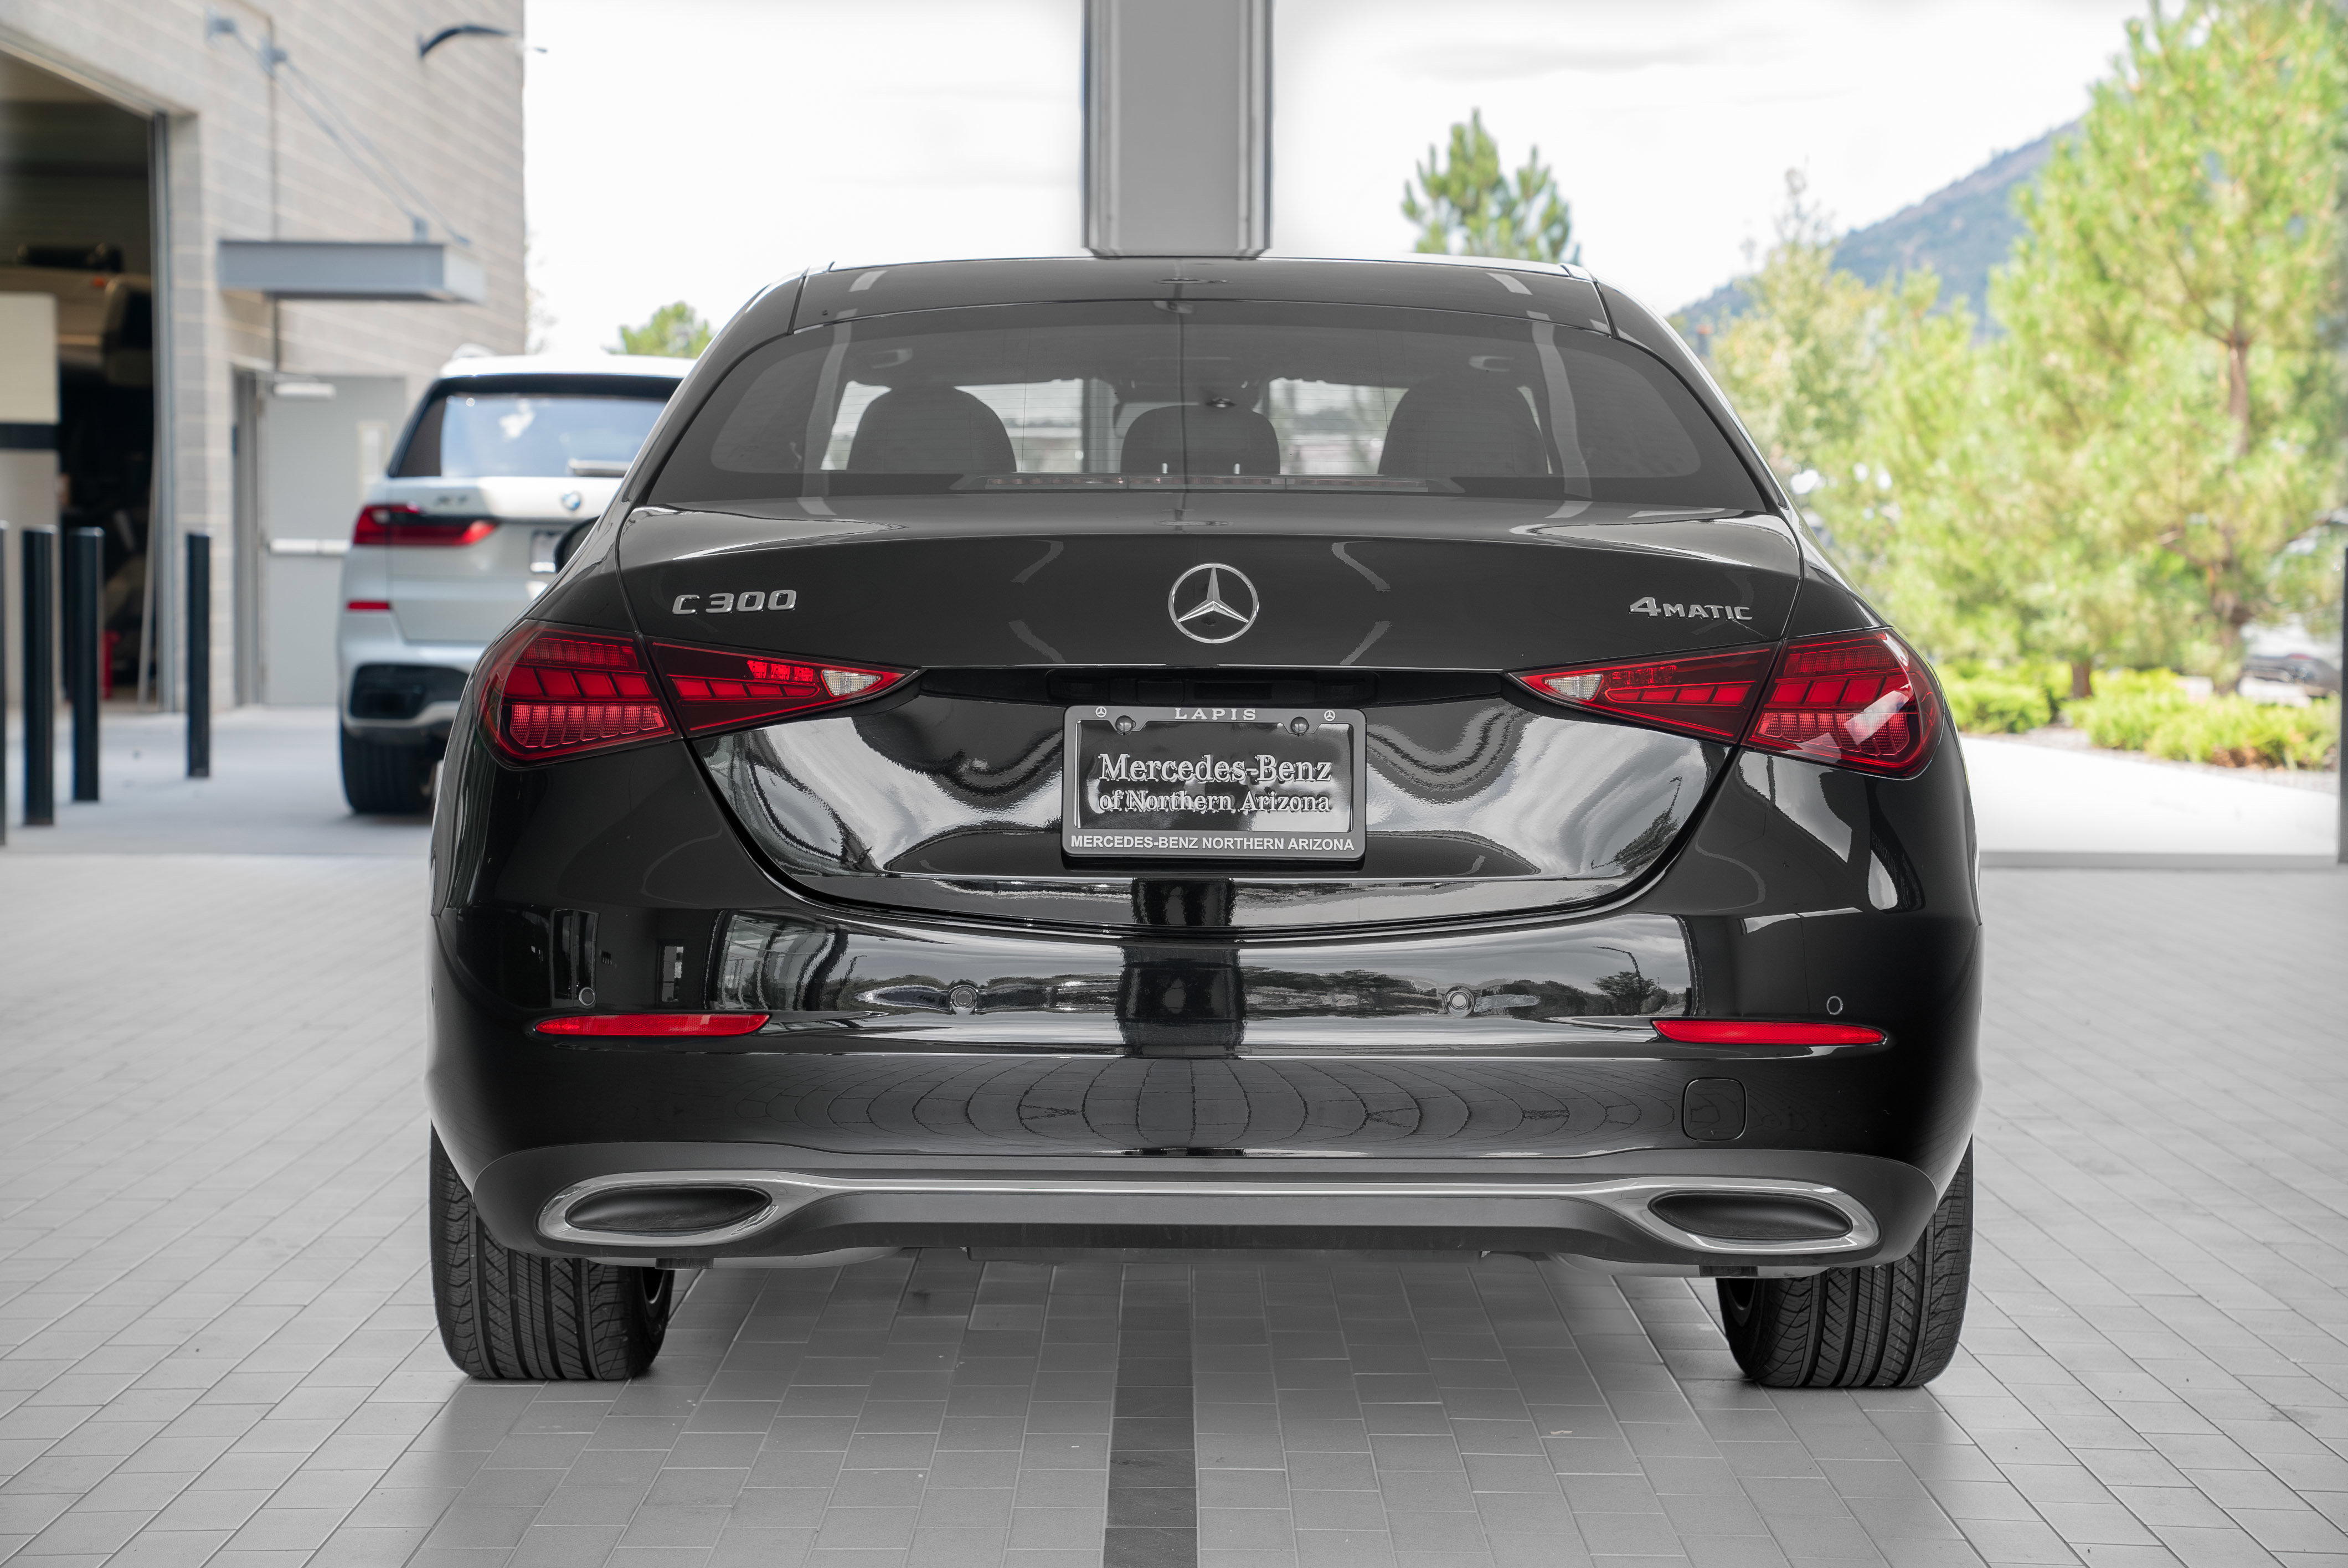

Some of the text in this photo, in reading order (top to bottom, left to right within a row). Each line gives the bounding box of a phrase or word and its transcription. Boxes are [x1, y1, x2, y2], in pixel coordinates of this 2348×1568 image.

[672, 590, 797, 615] C 300
[1629, 596, 1753, 621] 4MATIC
[1175, 708, 1257, 721] LAPIS
[1099, 754, 1332, 782] Mercedes-Benz
[1099, 790, 1330, 814] of Northern Arizona
[1070, 835, 1355, 851] MERCEDES-BENZ NORTHERN ARIZONA
